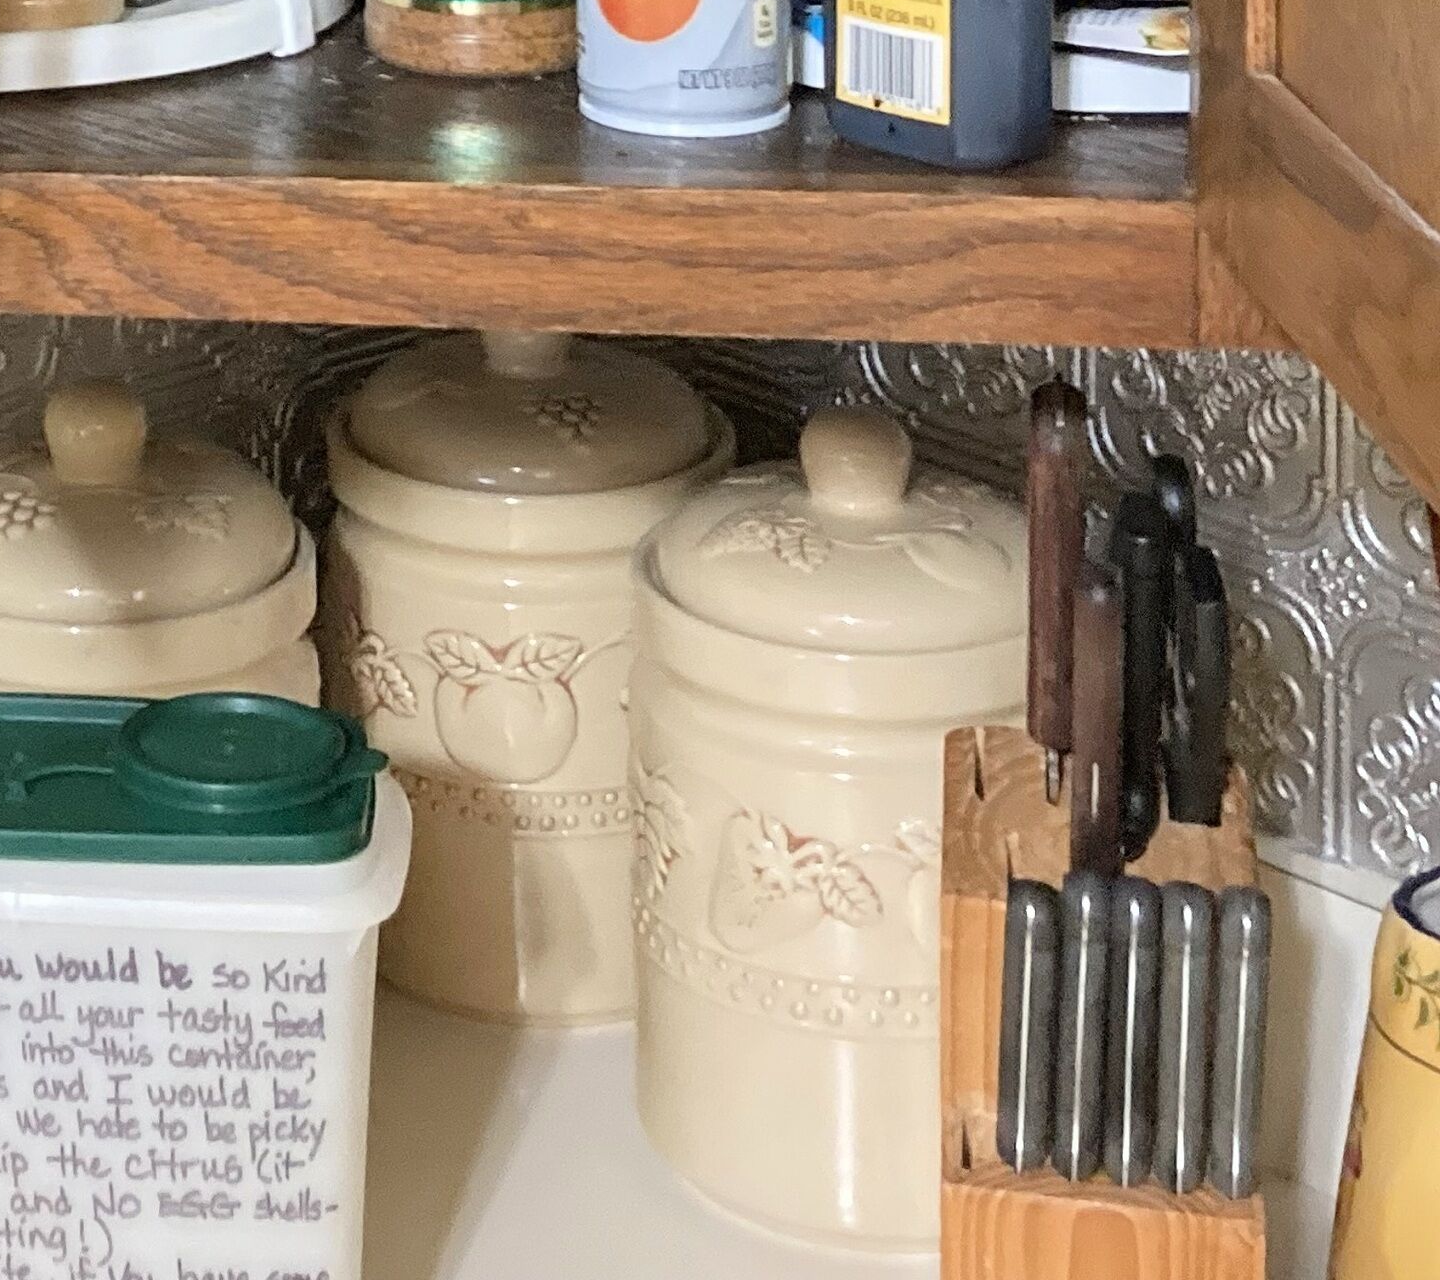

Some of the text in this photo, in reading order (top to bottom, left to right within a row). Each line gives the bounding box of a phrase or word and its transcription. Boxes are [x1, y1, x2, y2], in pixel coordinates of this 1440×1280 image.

[35, 946, 140, 985] would
[155, 948, 193, 991] be
[211, 961, 251, 990] so
[19, 990, 65, 1023] all
[77, 1005, 145, 1047] your
[157, 997, 253, 1043] tasty
[21, 1030, 76, 1065] into
[89, 1032, 155, 1068] this
[33, 1067, 89, 1103] and
[106, 1073, 134, 1106] I
[147, 1074, 251, 1109] would
[272, 1076, 312, 1111] be
[76, 1107, 142, 1141] hate
[151, 1108, 189, 1141] to
[203, 1109, 238, 1142] be
[248, 1109, 327, 1164] picky
[46, 1141, 112, 1178] the
[124, 1146, 244, 1184] citrus
[10, 1186, 72, 1217] and
